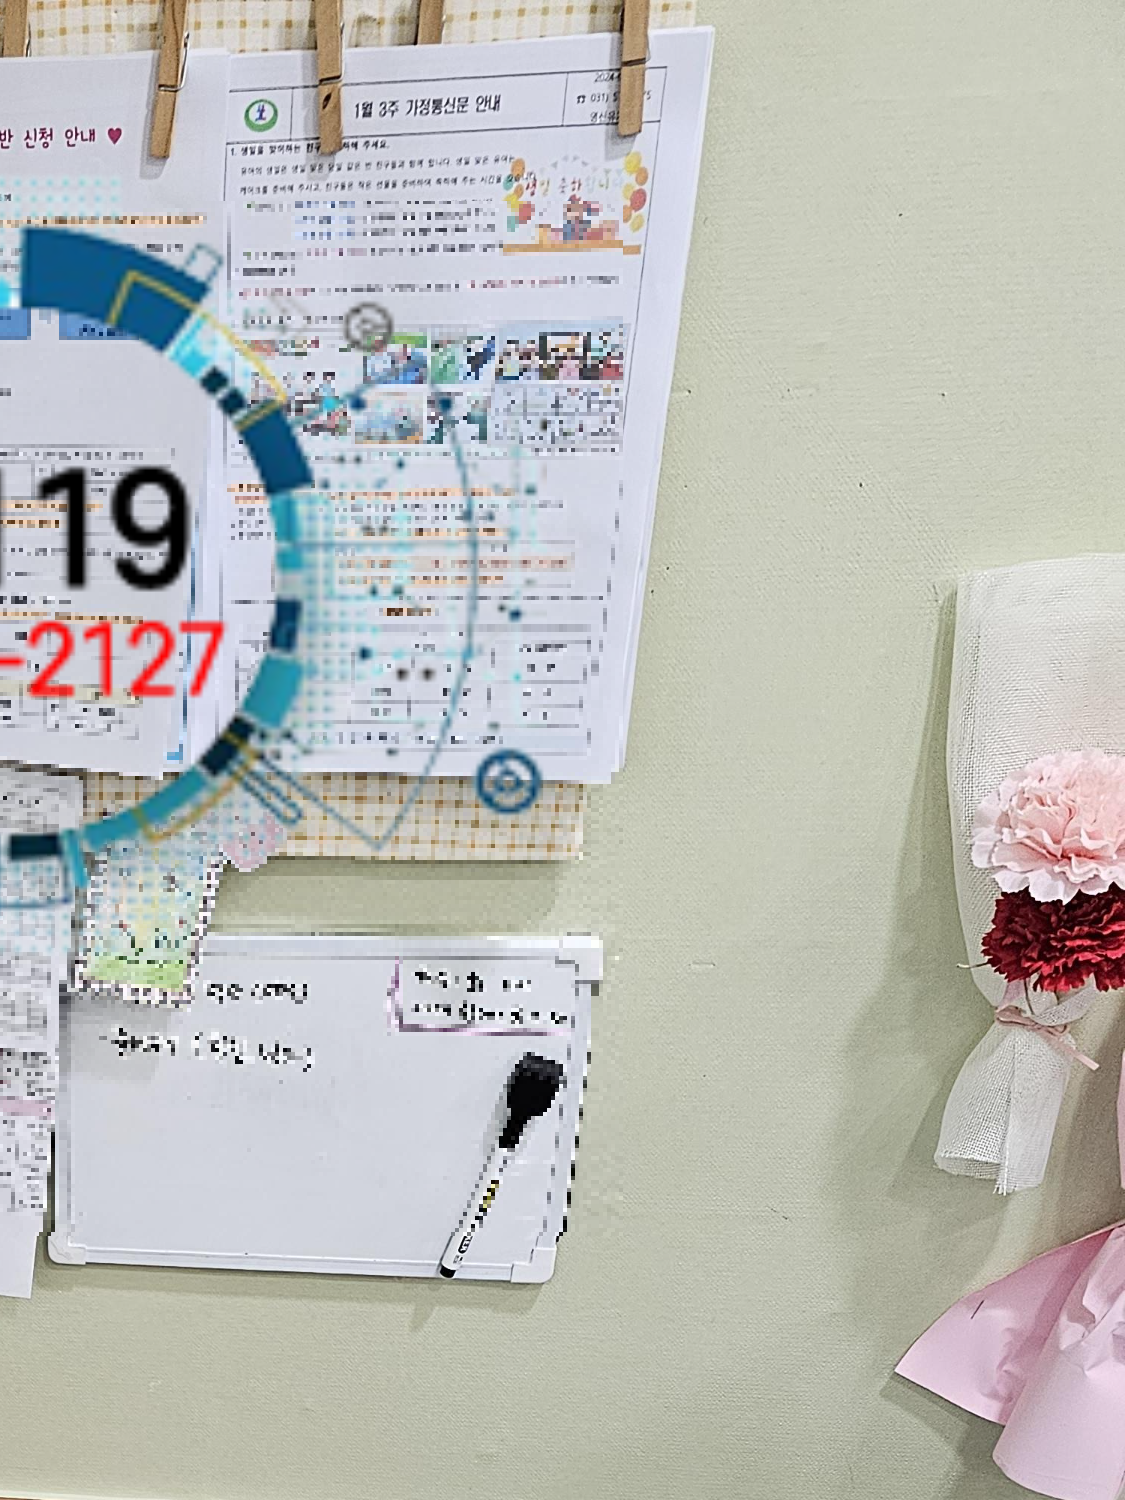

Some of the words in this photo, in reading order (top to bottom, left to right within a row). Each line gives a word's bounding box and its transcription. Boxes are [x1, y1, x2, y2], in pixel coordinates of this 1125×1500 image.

[355, 102, 373, 119] 1월
[379, 101, 399, 118] 3주
[405, 96, 469, 116] 가정통신문
[475, 94, 501, 113] 안내
[24, 127, 53, 148] 신청
[65, 126, 96, 147] 안내
